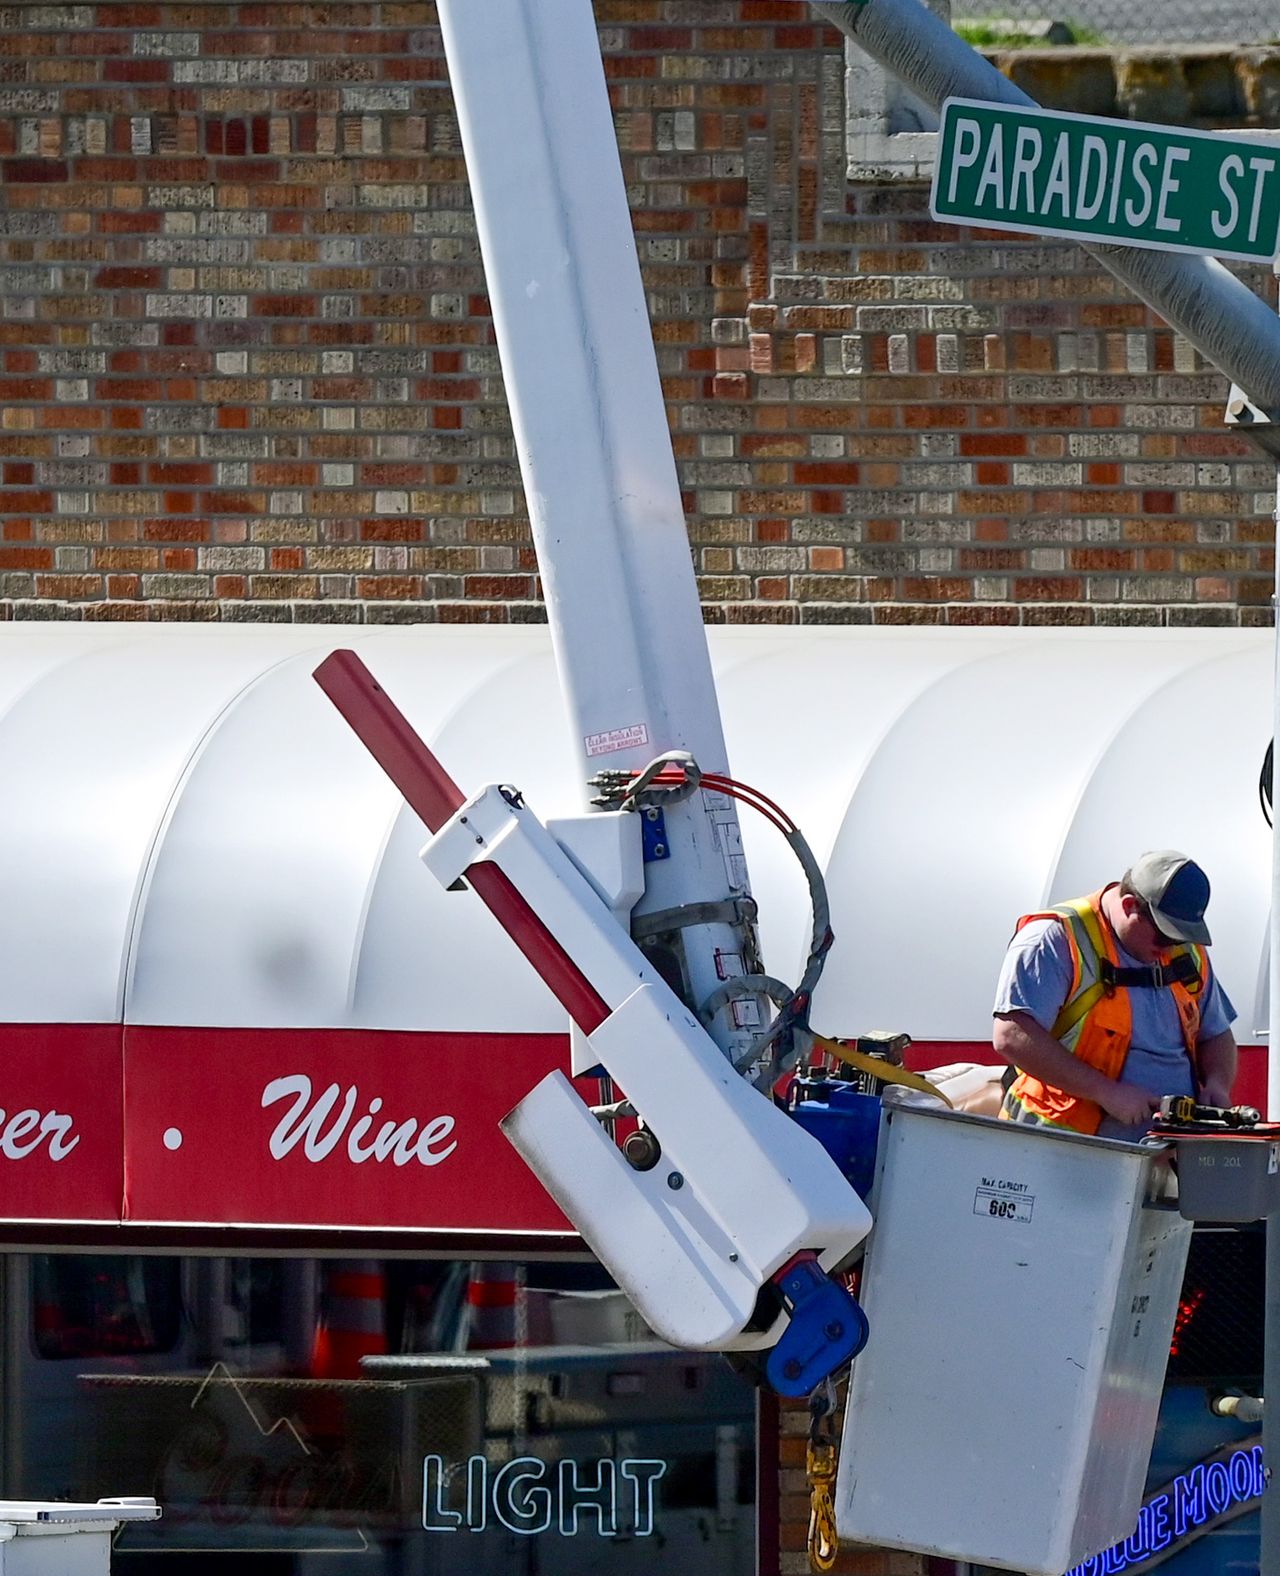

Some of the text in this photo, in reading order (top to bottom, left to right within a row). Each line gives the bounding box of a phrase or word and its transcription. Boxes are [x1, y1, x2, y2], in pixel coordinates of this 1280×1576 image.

[947, 117, 1276, 243] PARADISE ST
[261, 1073, 458, 1167] Wine
[989, 1199, 1017, 1219] 600
[422, 1453, 667, 1537] LIGHT
